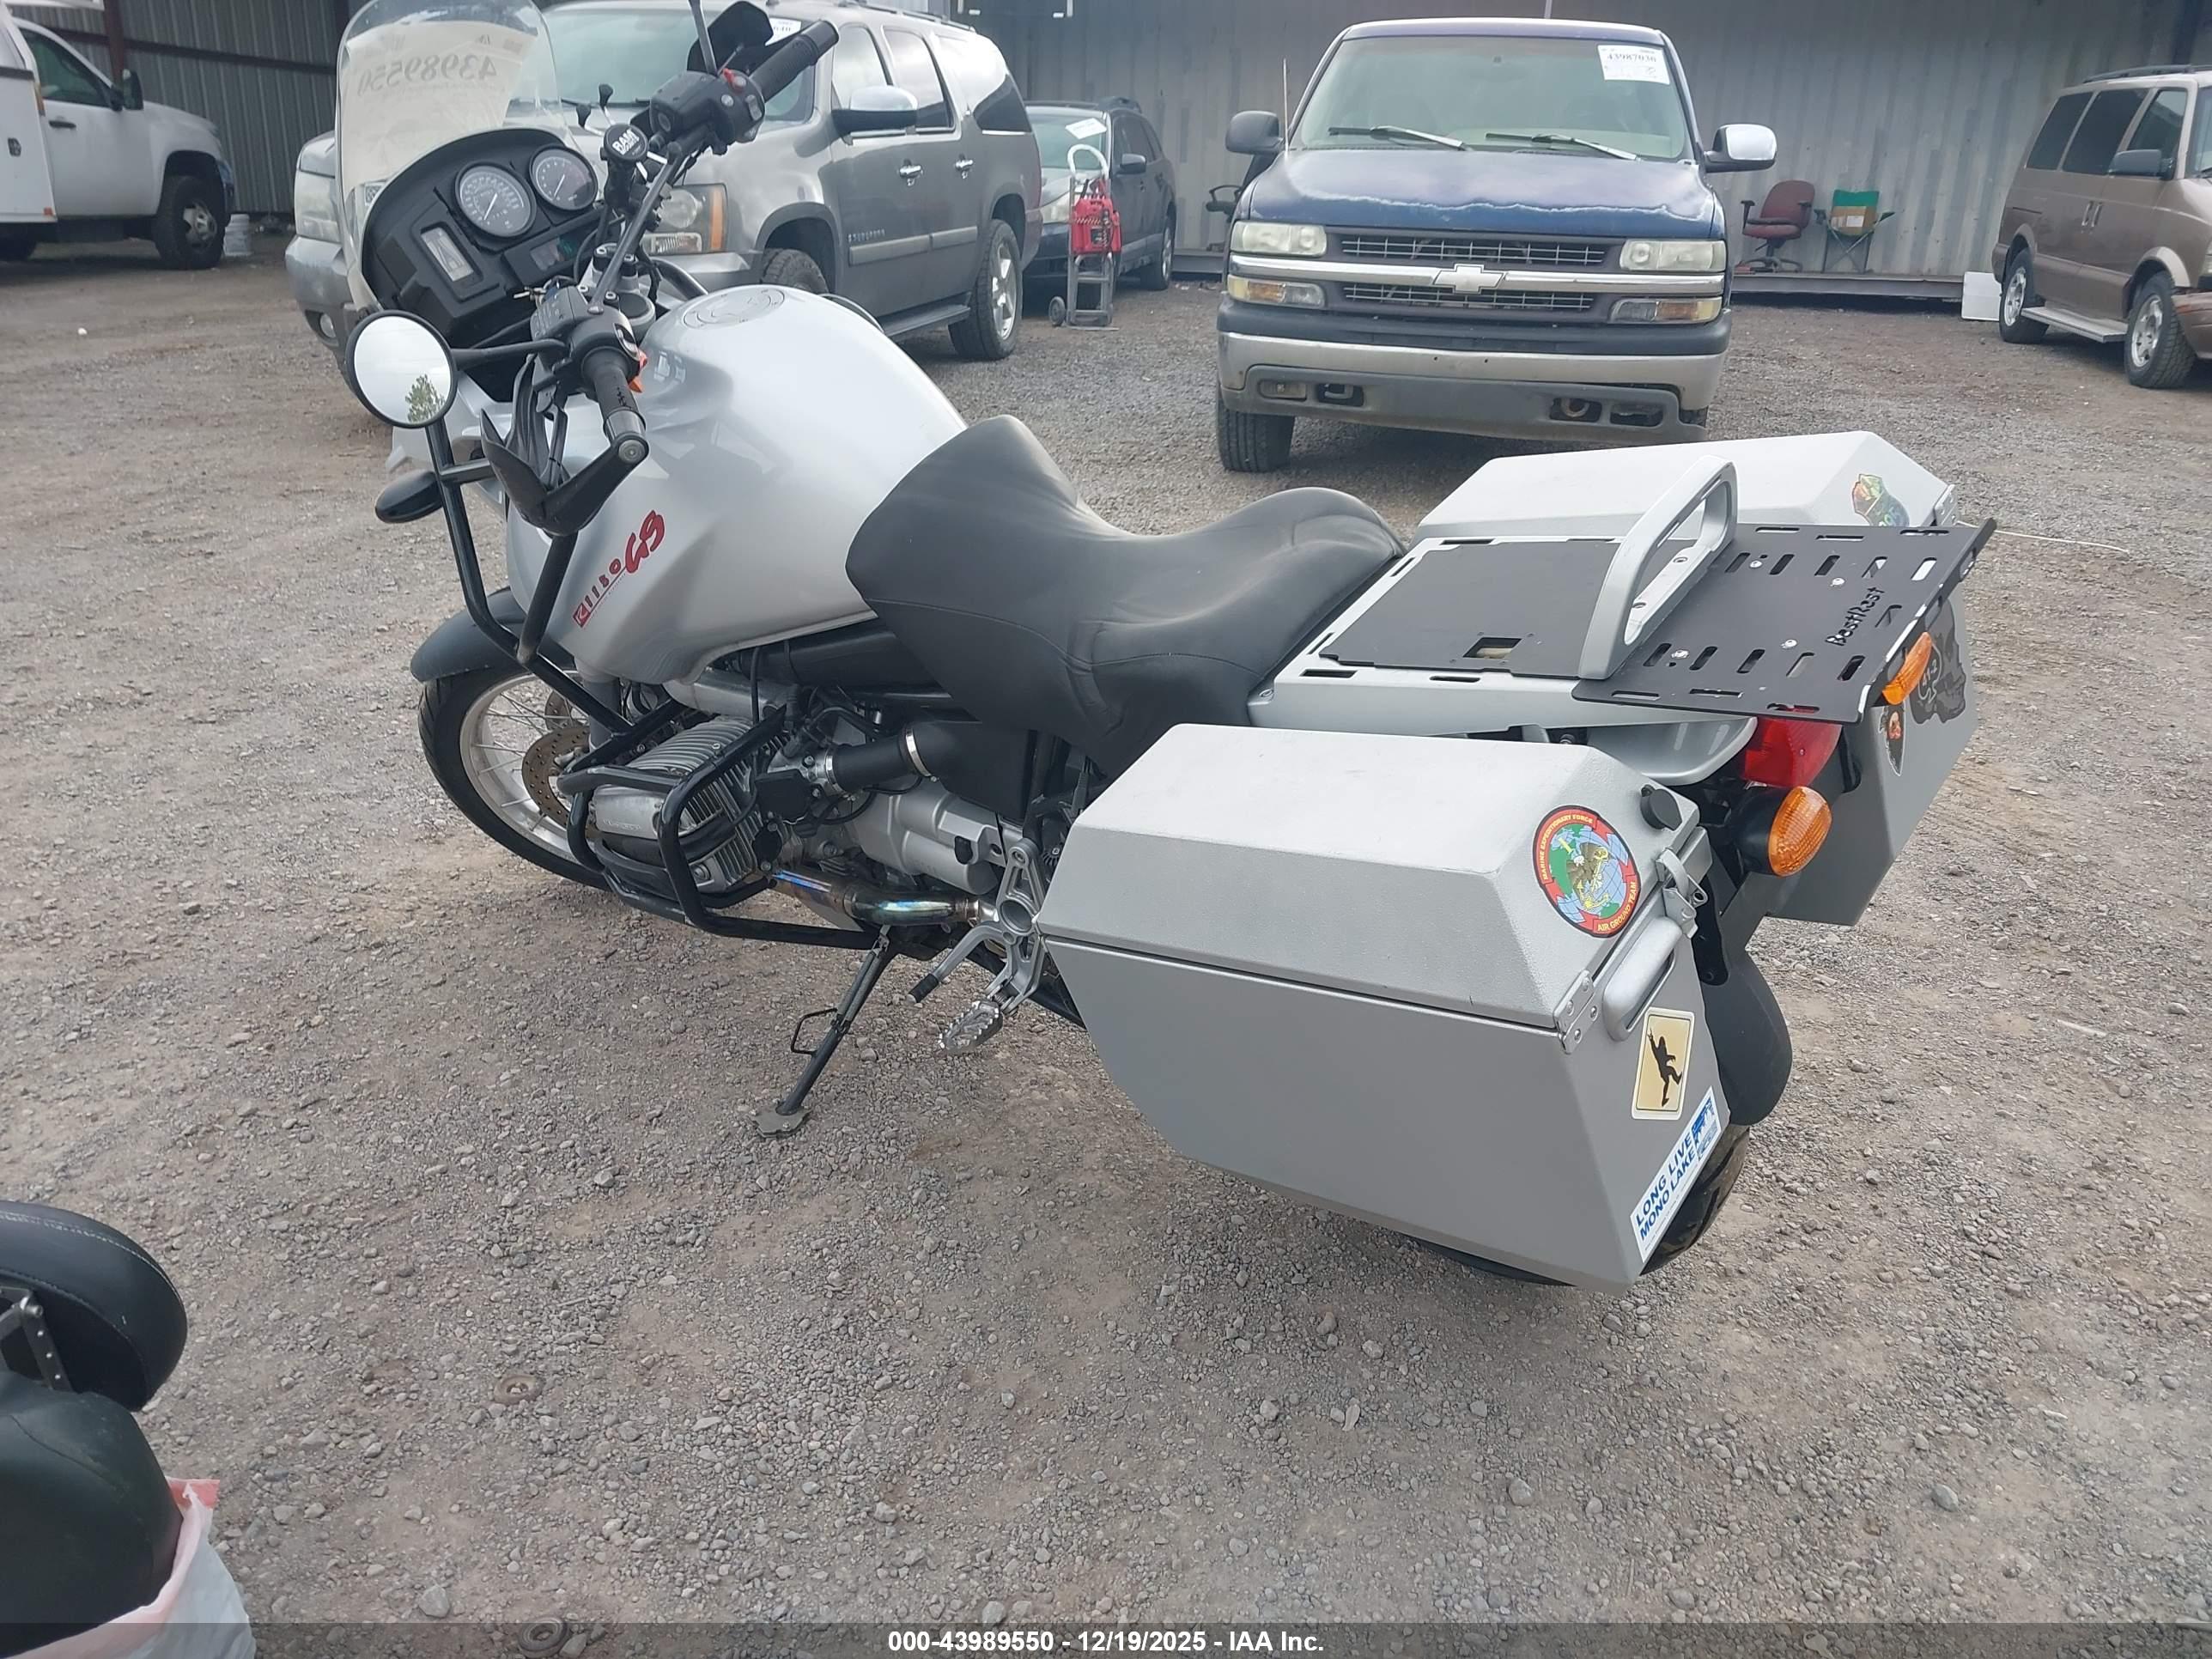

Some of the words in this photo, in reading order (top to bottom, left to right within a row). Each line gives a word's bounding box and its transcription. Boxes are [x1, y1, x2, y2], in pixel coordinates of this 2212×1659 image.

[1572, 814, 1594, 824] FORCE
[1597, 922, 1611, 932] AIR
[1609, 903, 1631, 929] GROUND
[1628, 881, 1637, 903] TEAM
[1636, 1174, 1667, 1227] LONG
[1668, 1132, 1692, 1175] LIVE
[1639, 1189, 1670, 1242] MONO
[1670, 1148, 1697, 1192] LAKE
